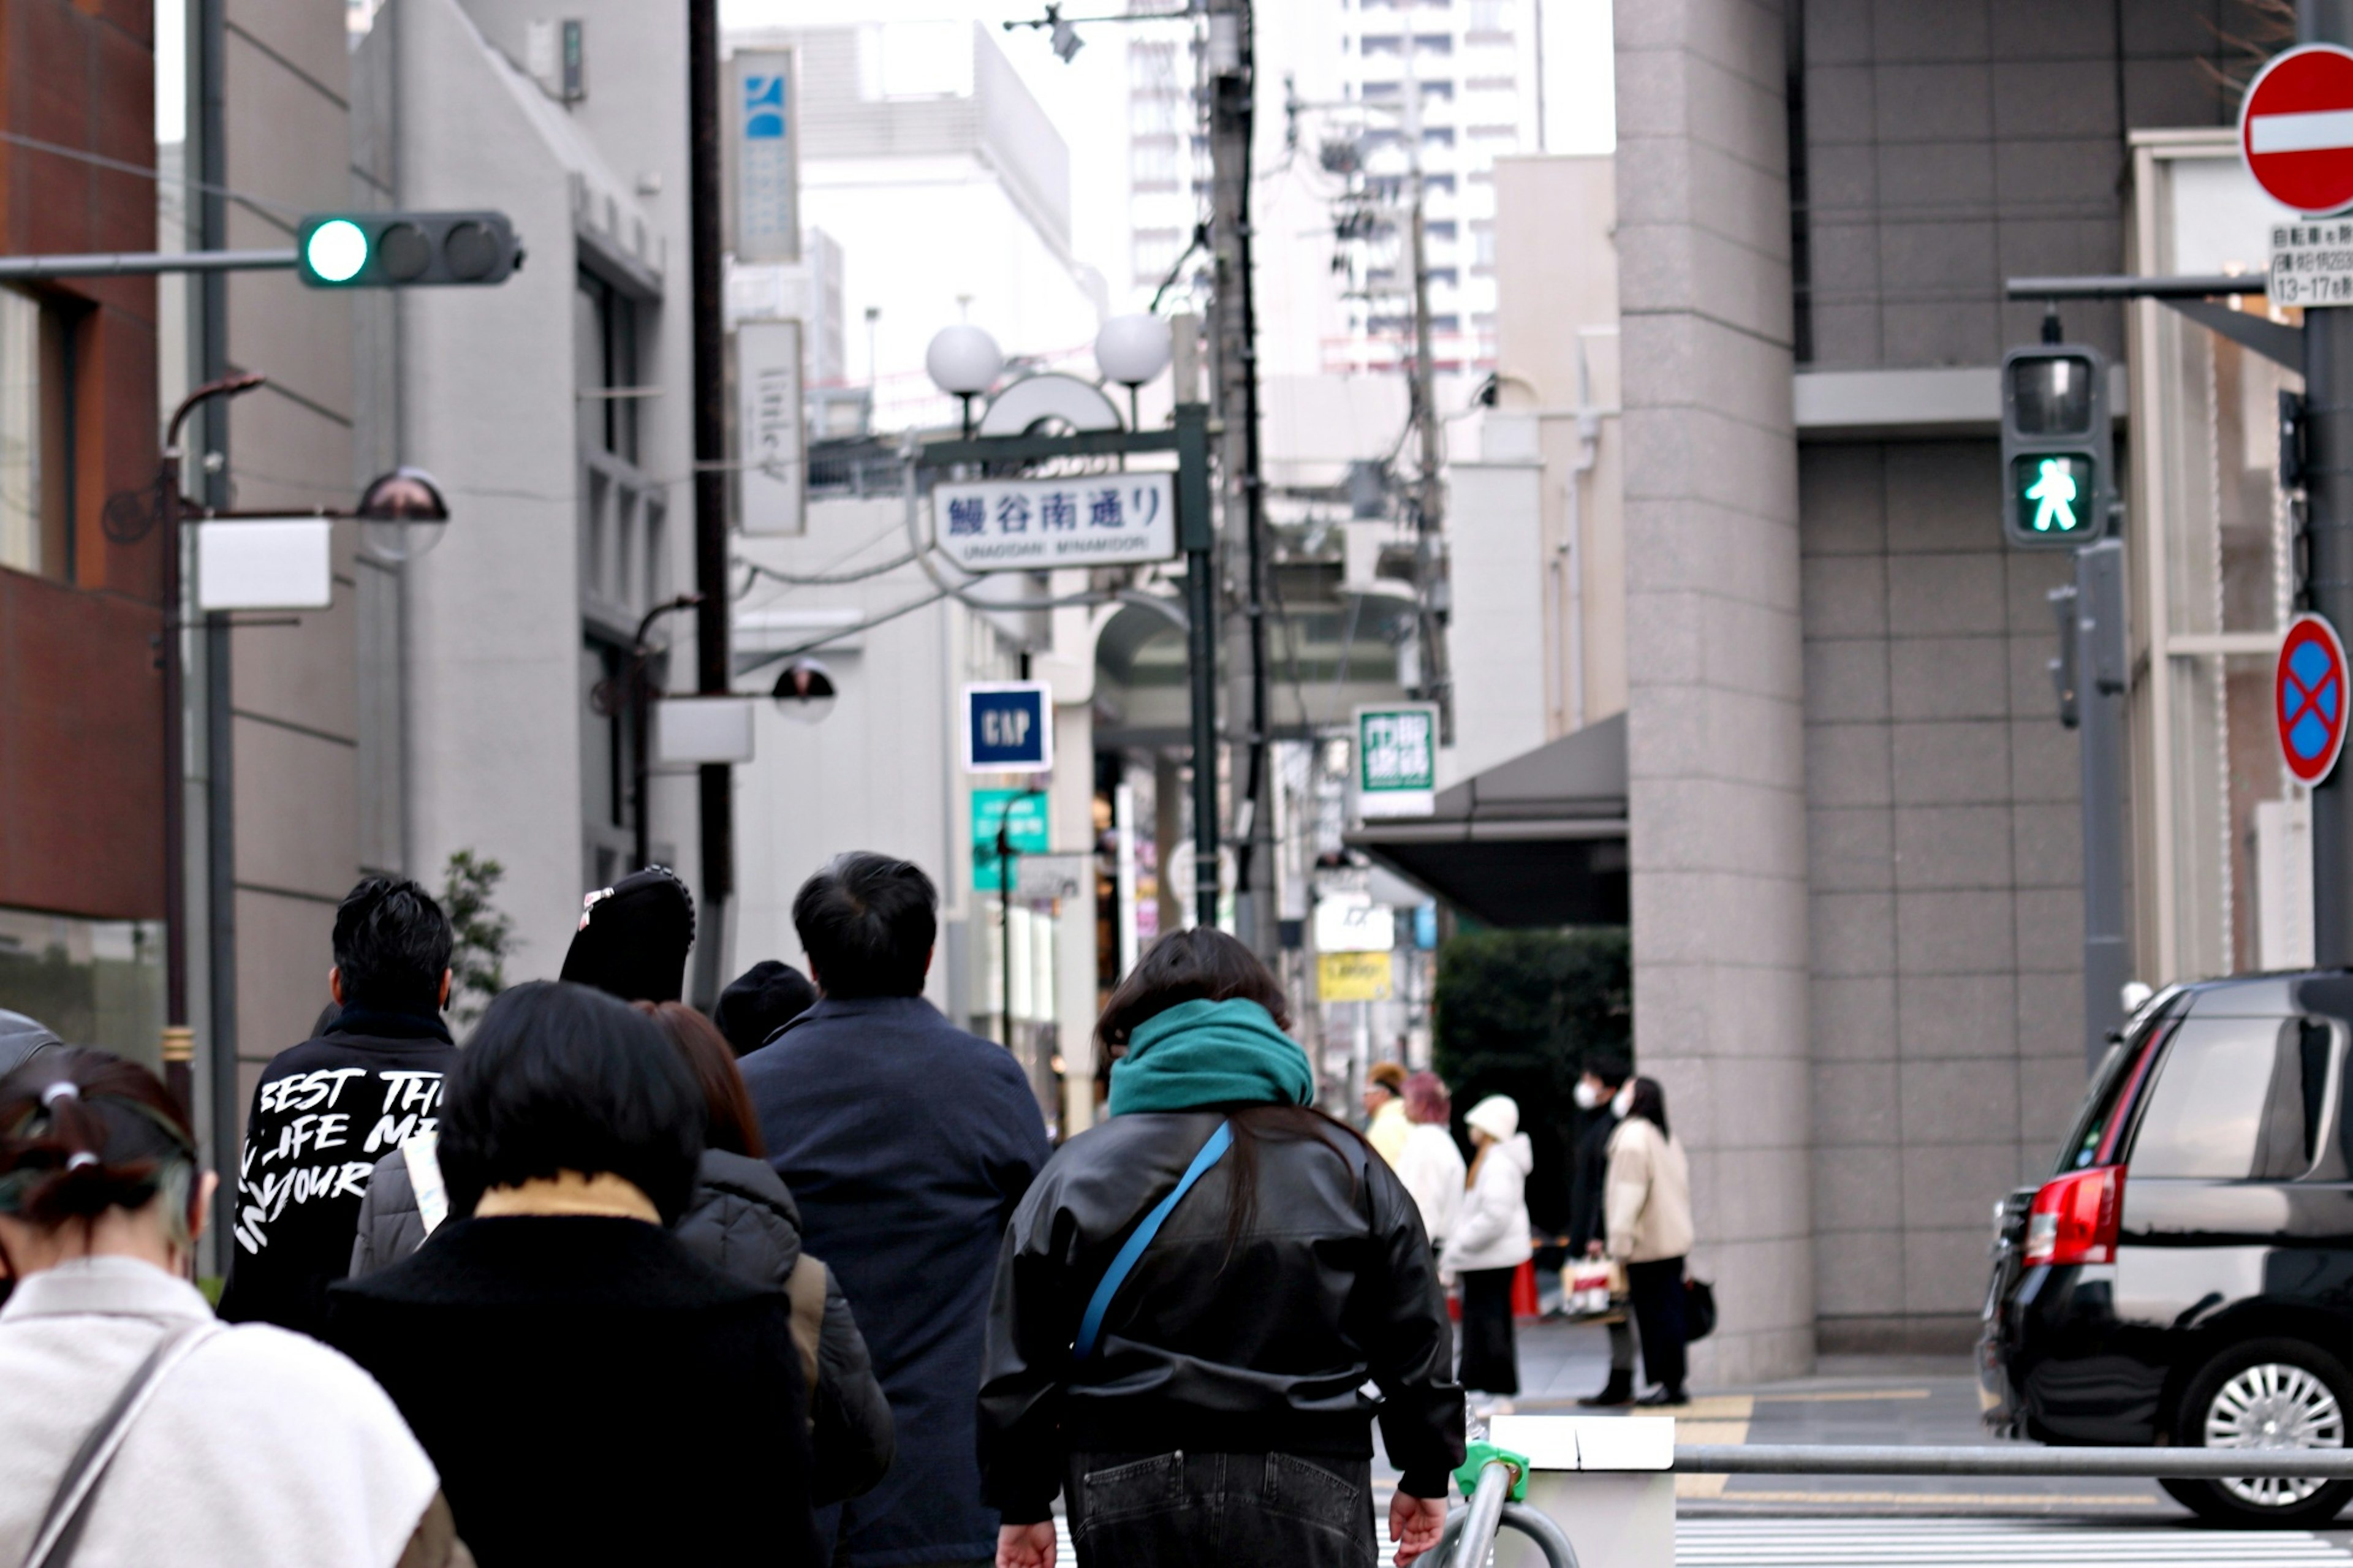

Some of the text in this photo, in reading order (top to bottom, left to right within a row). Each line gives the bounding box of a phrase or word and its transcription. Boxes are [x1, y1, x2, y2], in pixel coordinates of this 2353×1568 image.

[948, 487, 1161, 536] 鰻谷南通り
[981, 708, 1030, 747] GAP
[260, 1067, 368, 1113] BEST
